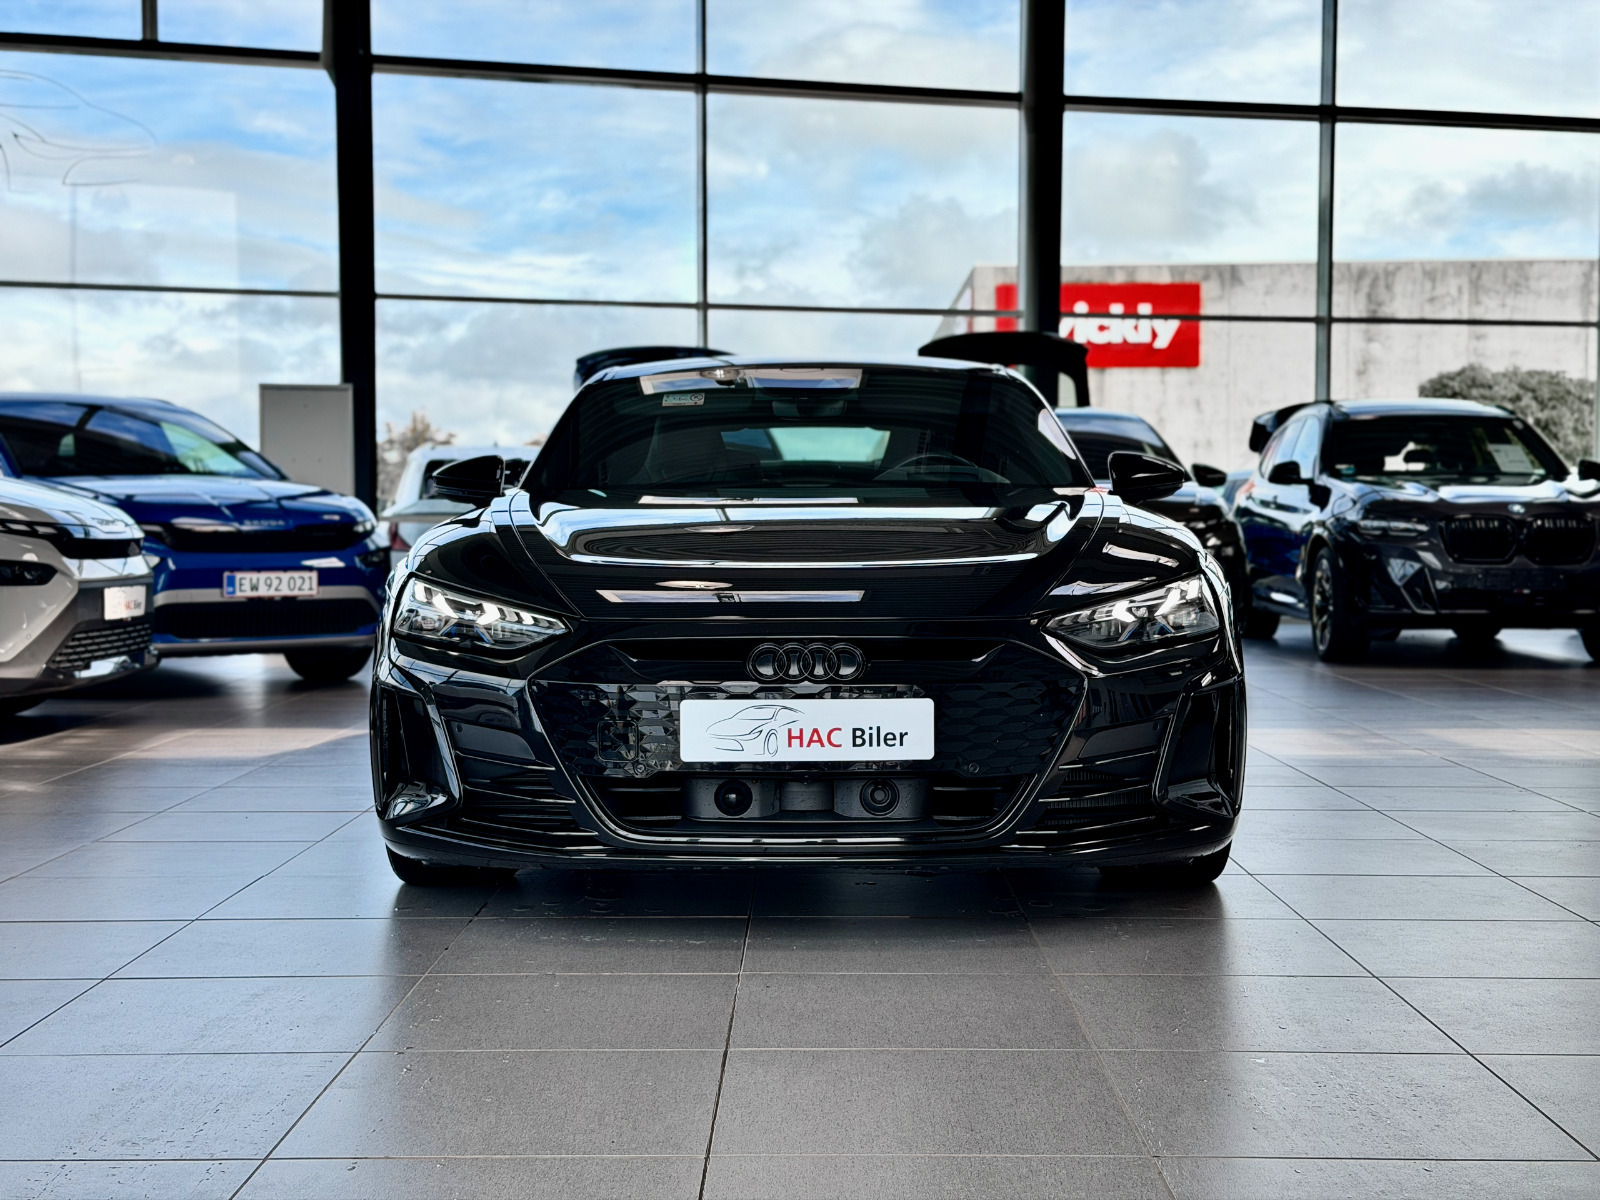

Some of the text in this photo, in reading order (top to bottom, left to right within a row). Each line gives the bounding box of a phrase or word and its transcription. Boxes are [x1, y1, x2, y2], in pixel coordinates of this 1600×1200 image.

[1058, 300, 1181, 349] vickly
[238, 576, 260, 593] EW
[264, 576, 283, 592] 92
[287, 575, 315, 592] 021
[787, 726, 909, 748] HAC Biler
